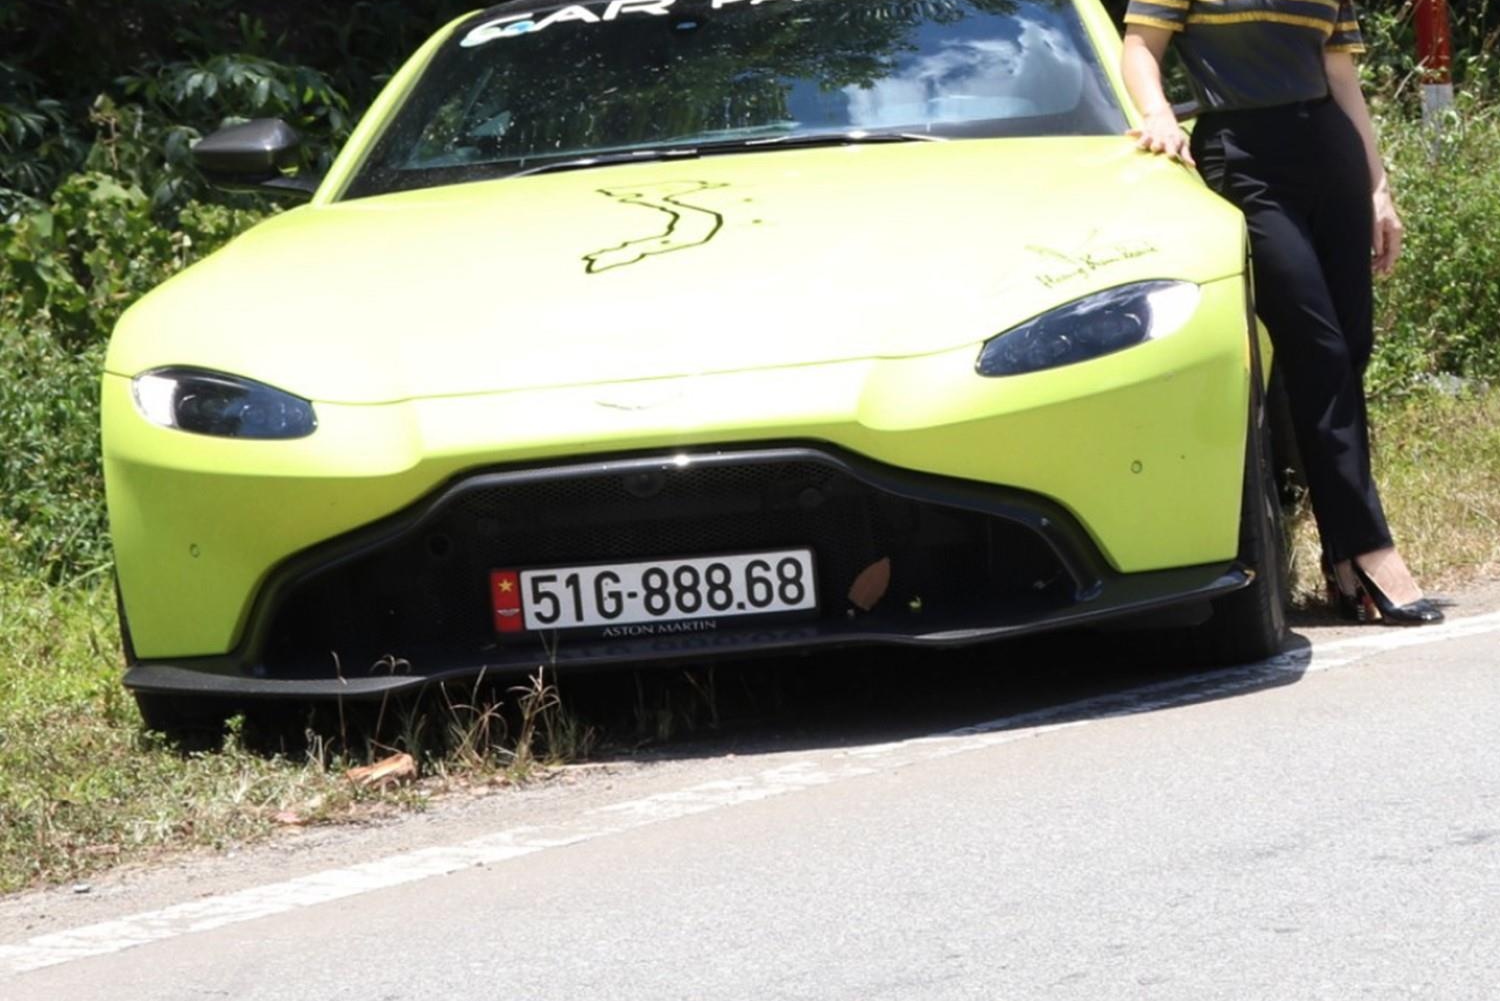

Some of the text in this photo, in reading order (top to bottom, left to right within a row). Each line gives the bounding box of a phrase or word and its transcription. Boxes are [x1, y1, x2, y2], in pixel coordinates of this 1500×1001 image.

[530, 556, 805, 624] 51G-888.68
[602, 619, 717, 638] ASTON MARTIN
